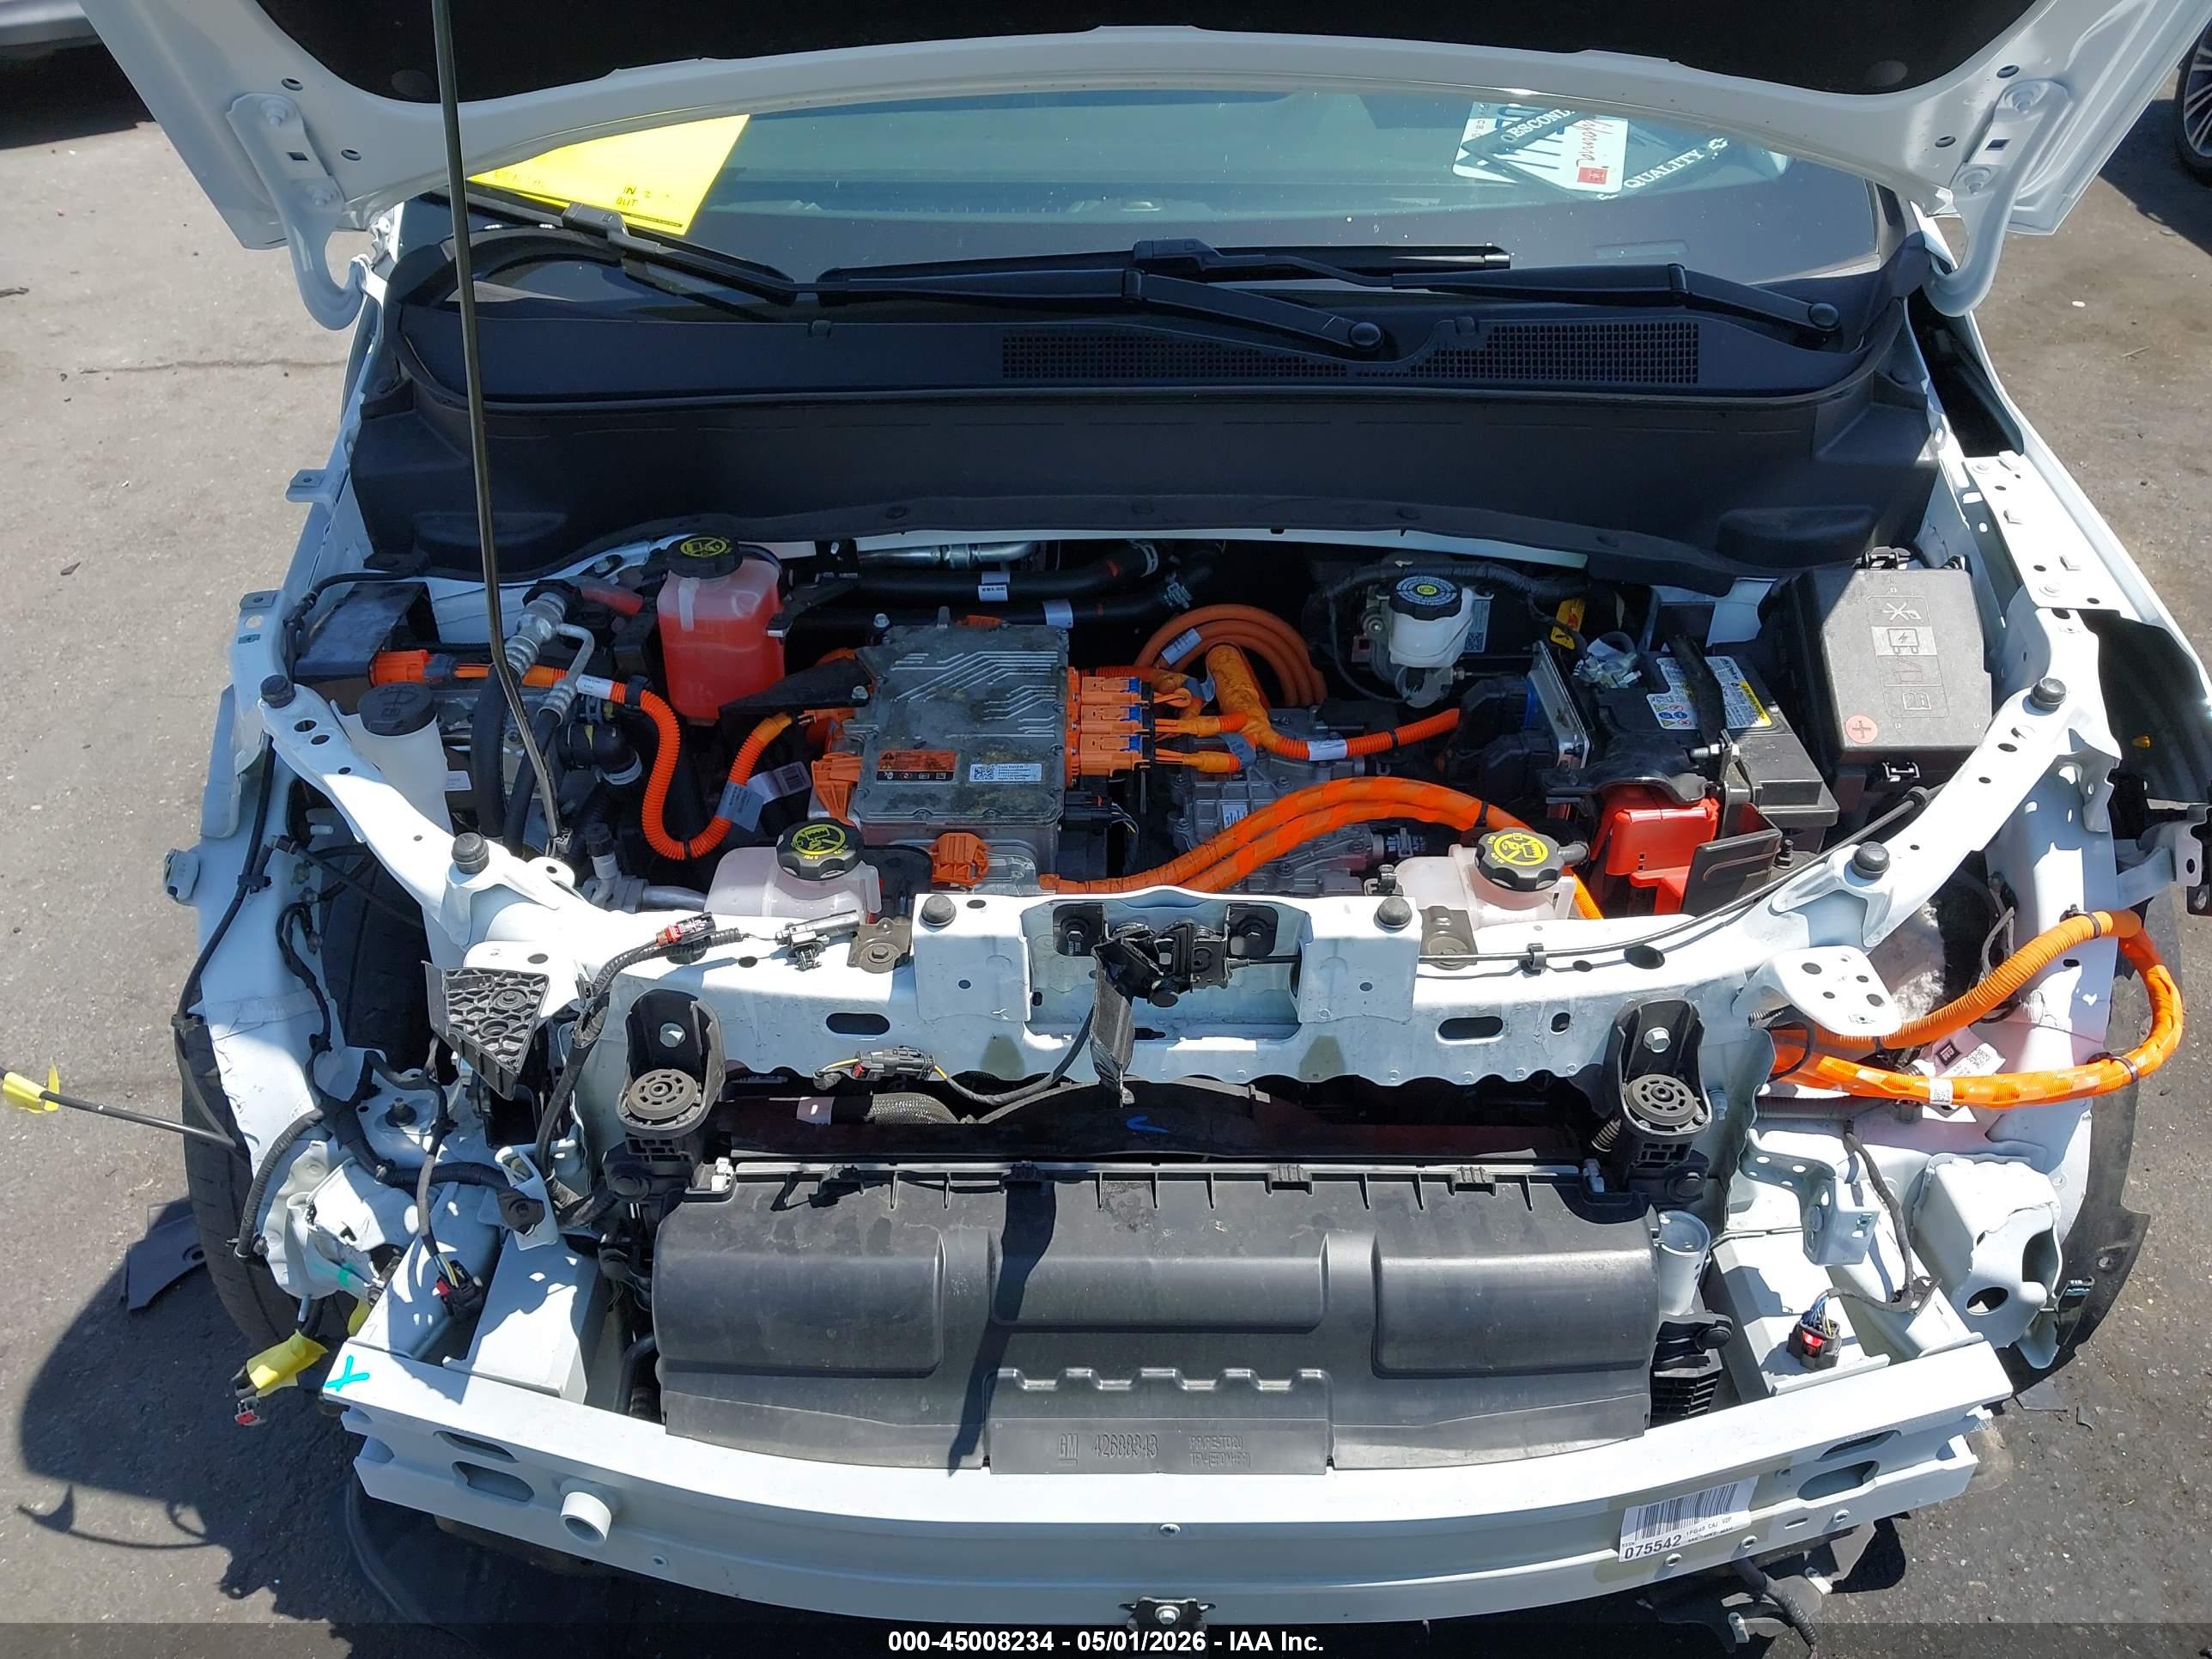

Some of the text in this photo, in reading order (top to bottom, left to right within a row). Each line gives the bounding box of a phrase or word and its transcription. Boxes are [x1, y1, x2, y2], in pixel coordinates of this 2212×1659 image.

[1623, 149, 1705, 189] QUALITY
[1058, 1433, 1159, 1459] GM 42688343
[1624, 1534, 1682, 1559] 075542
